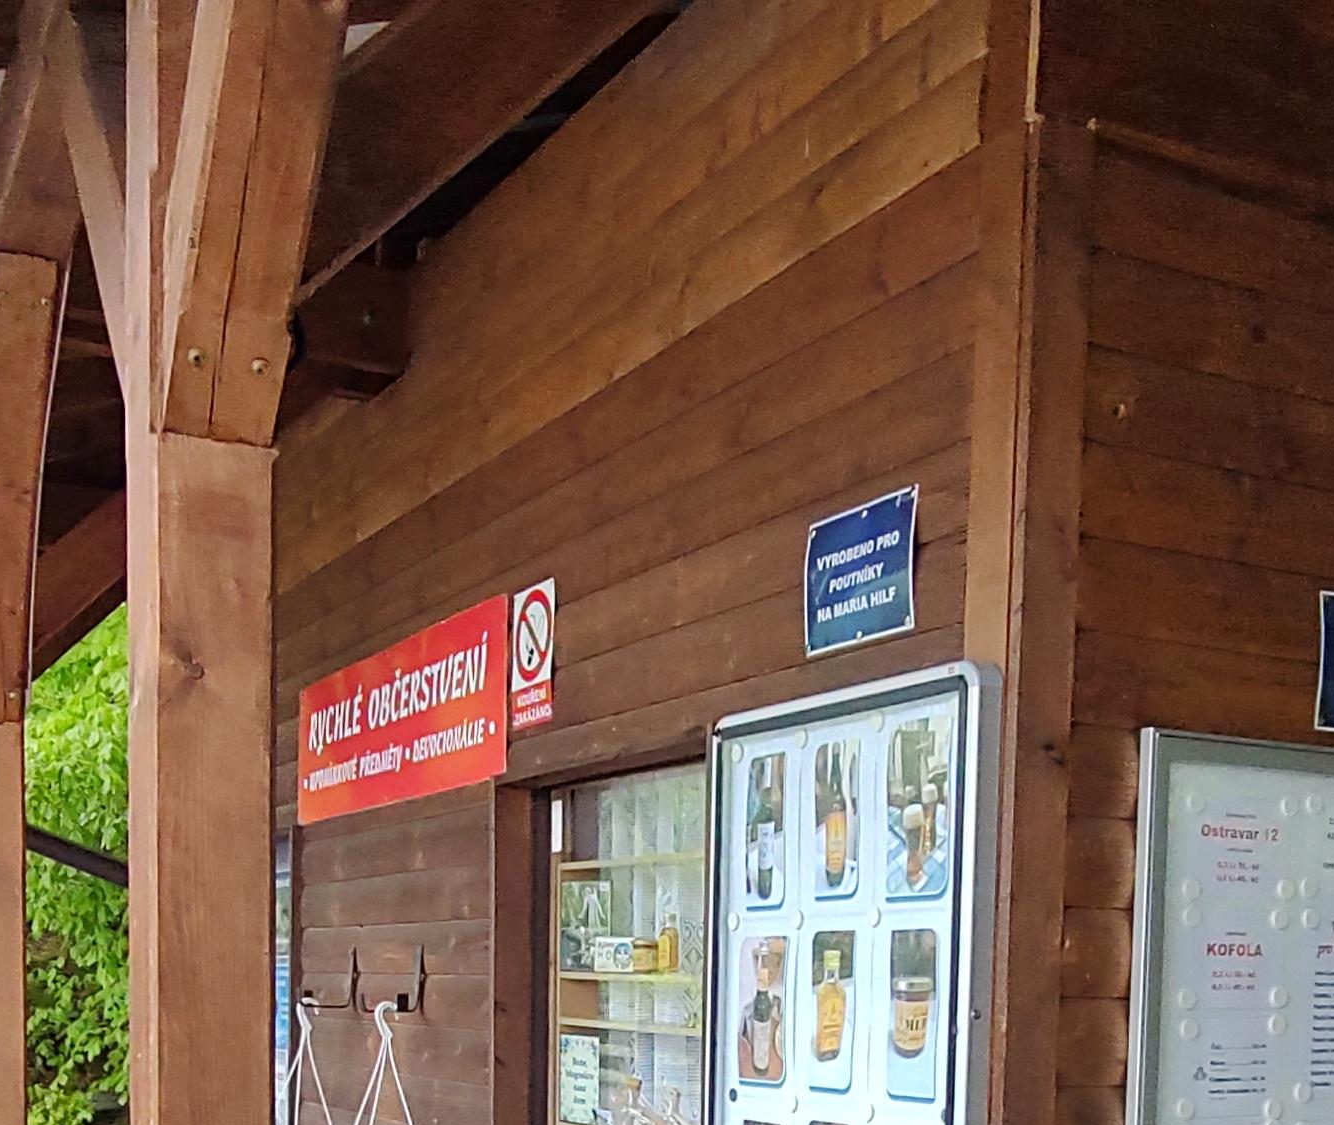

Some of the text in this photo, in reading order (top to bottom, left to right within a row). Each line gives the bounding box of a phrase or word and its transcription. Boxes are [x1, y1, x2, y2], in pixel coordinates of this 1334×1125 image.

[817, 530, 900, 571] VYROBENO PRO
[829, 562, 884, 593] POUTNÍKY
[817, 586, 896, 623] NA MARIA HILF
[308, 631, 488, 755] RYCHLÉ OBČERSTVENÍ
[359, 743, 403, 772] PŘEDMĚTY
[412, 718, 485, 762] DEVOCIONÁLIE
[1201, 824, 1259, 840] Ostravar
[1207, 943, 1262, 957] KOFOLA
